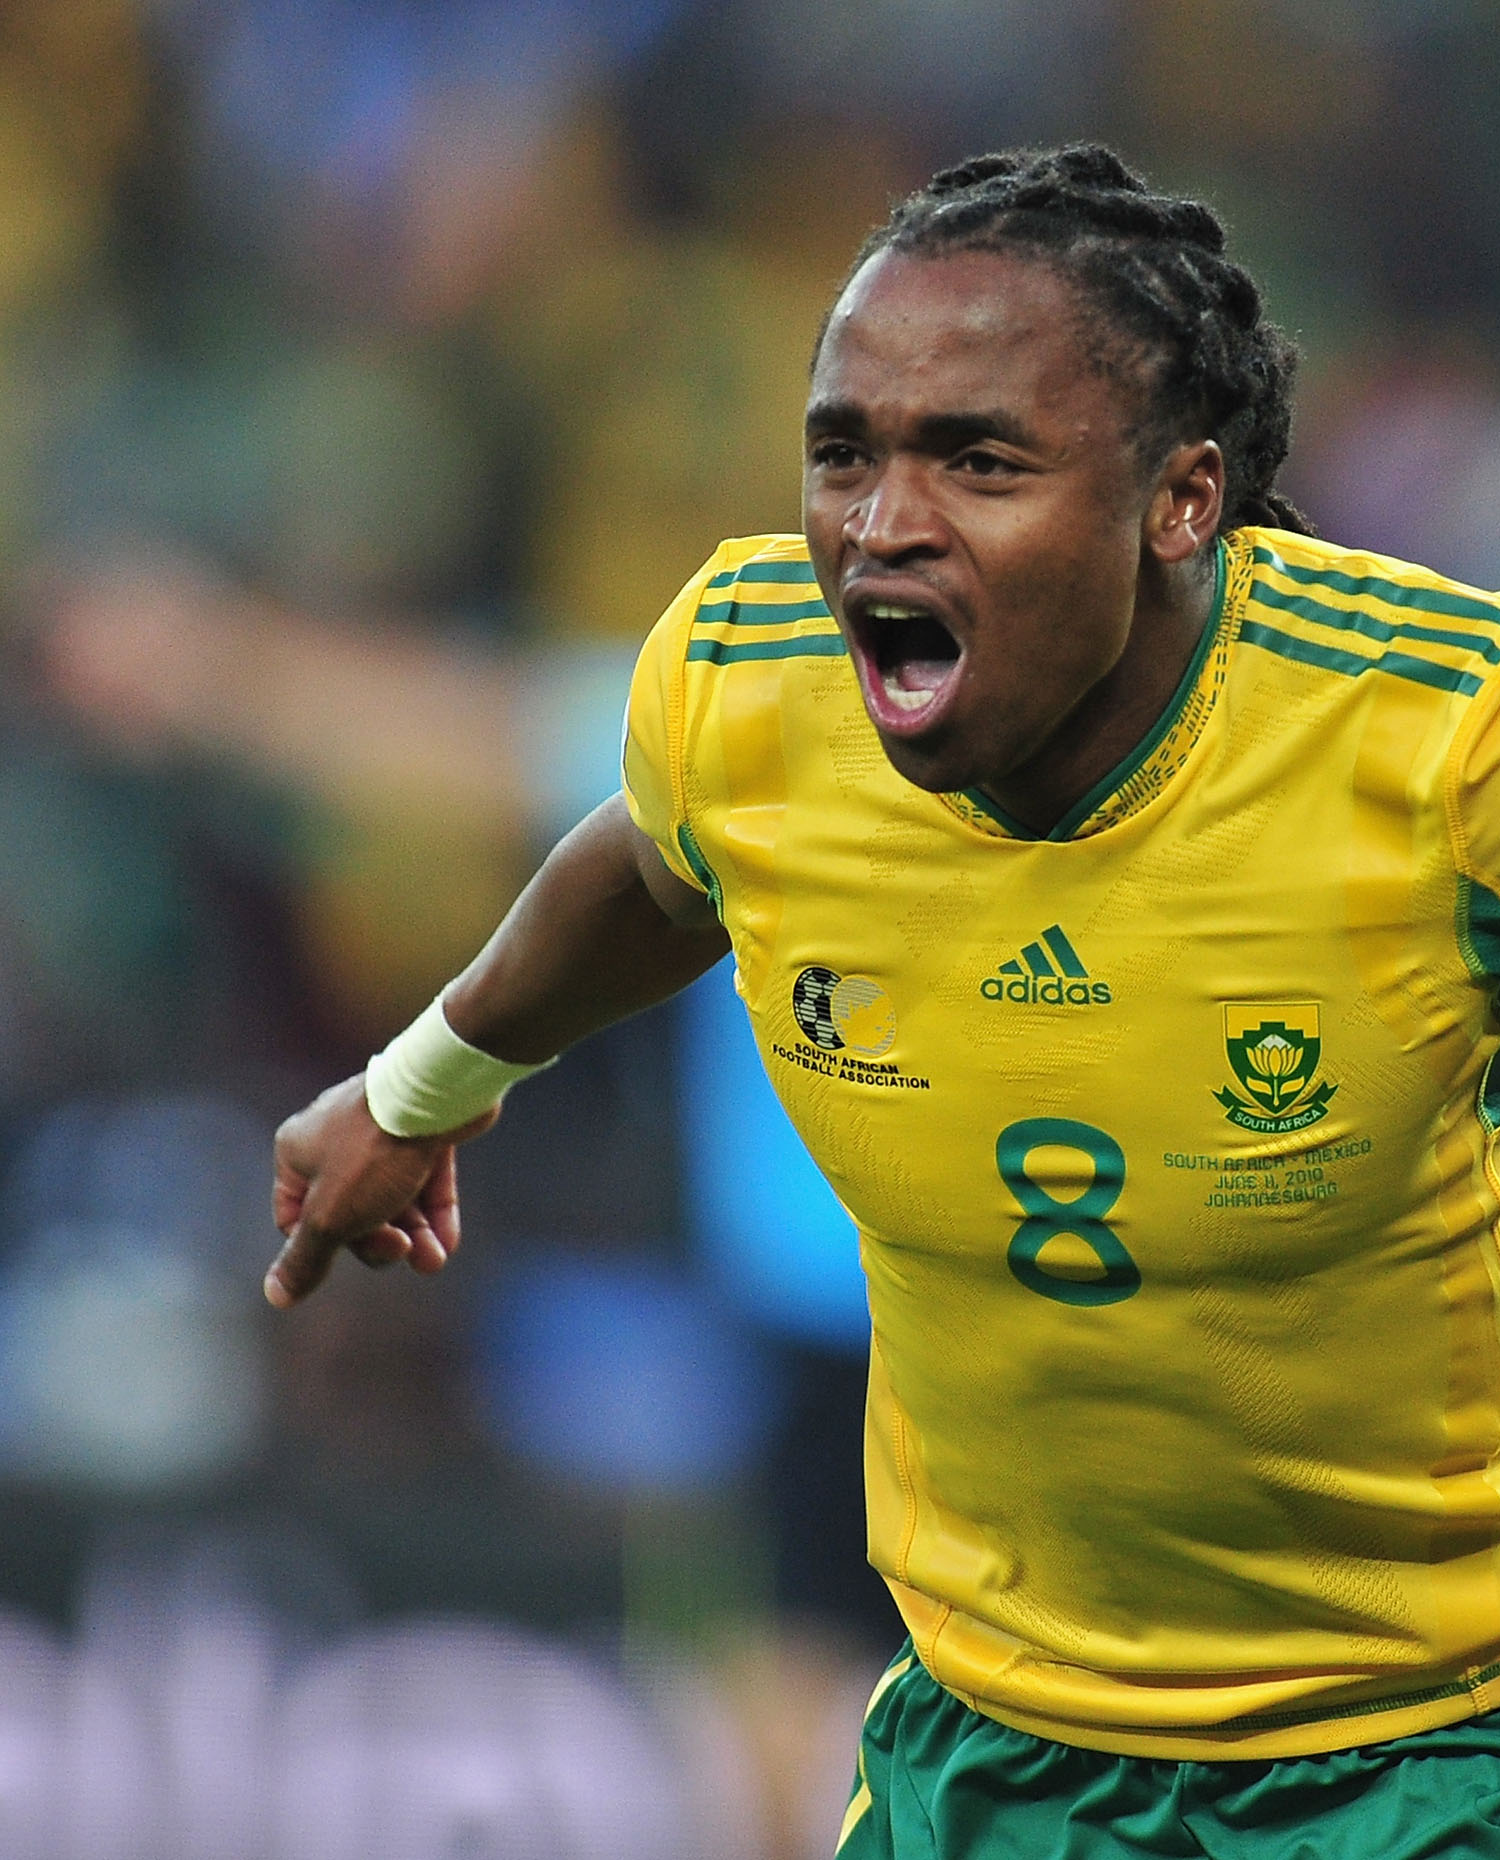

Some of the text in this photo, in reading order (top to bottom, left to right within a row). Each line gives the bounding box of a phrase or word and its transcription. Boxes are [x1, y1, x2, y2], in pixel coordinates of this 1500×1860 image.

[980, 974, 1112, 1005] adidas
[772, 1044, 930, 1089] FOOTBALL ASSOCIATION
[795, 1043, 900, 1075] SOUTH AFRICAN
[1235, 1109, 1321, 1131] SOUTH AFRICA
[1163, 1153, 1218, 1171] SOUTH
[1224, 1155, 1285, 1171] AFRICA
[1305, 1139, 1372, 1165] MEXICO
[1214, 1175, 1257, 1189] JUNE
[1285, 1167, 1323, 1186] 2010
[1204, 1181, 1338, 1208] JOHANNESBURG
[996, 1117, 1142, 1308] 8
